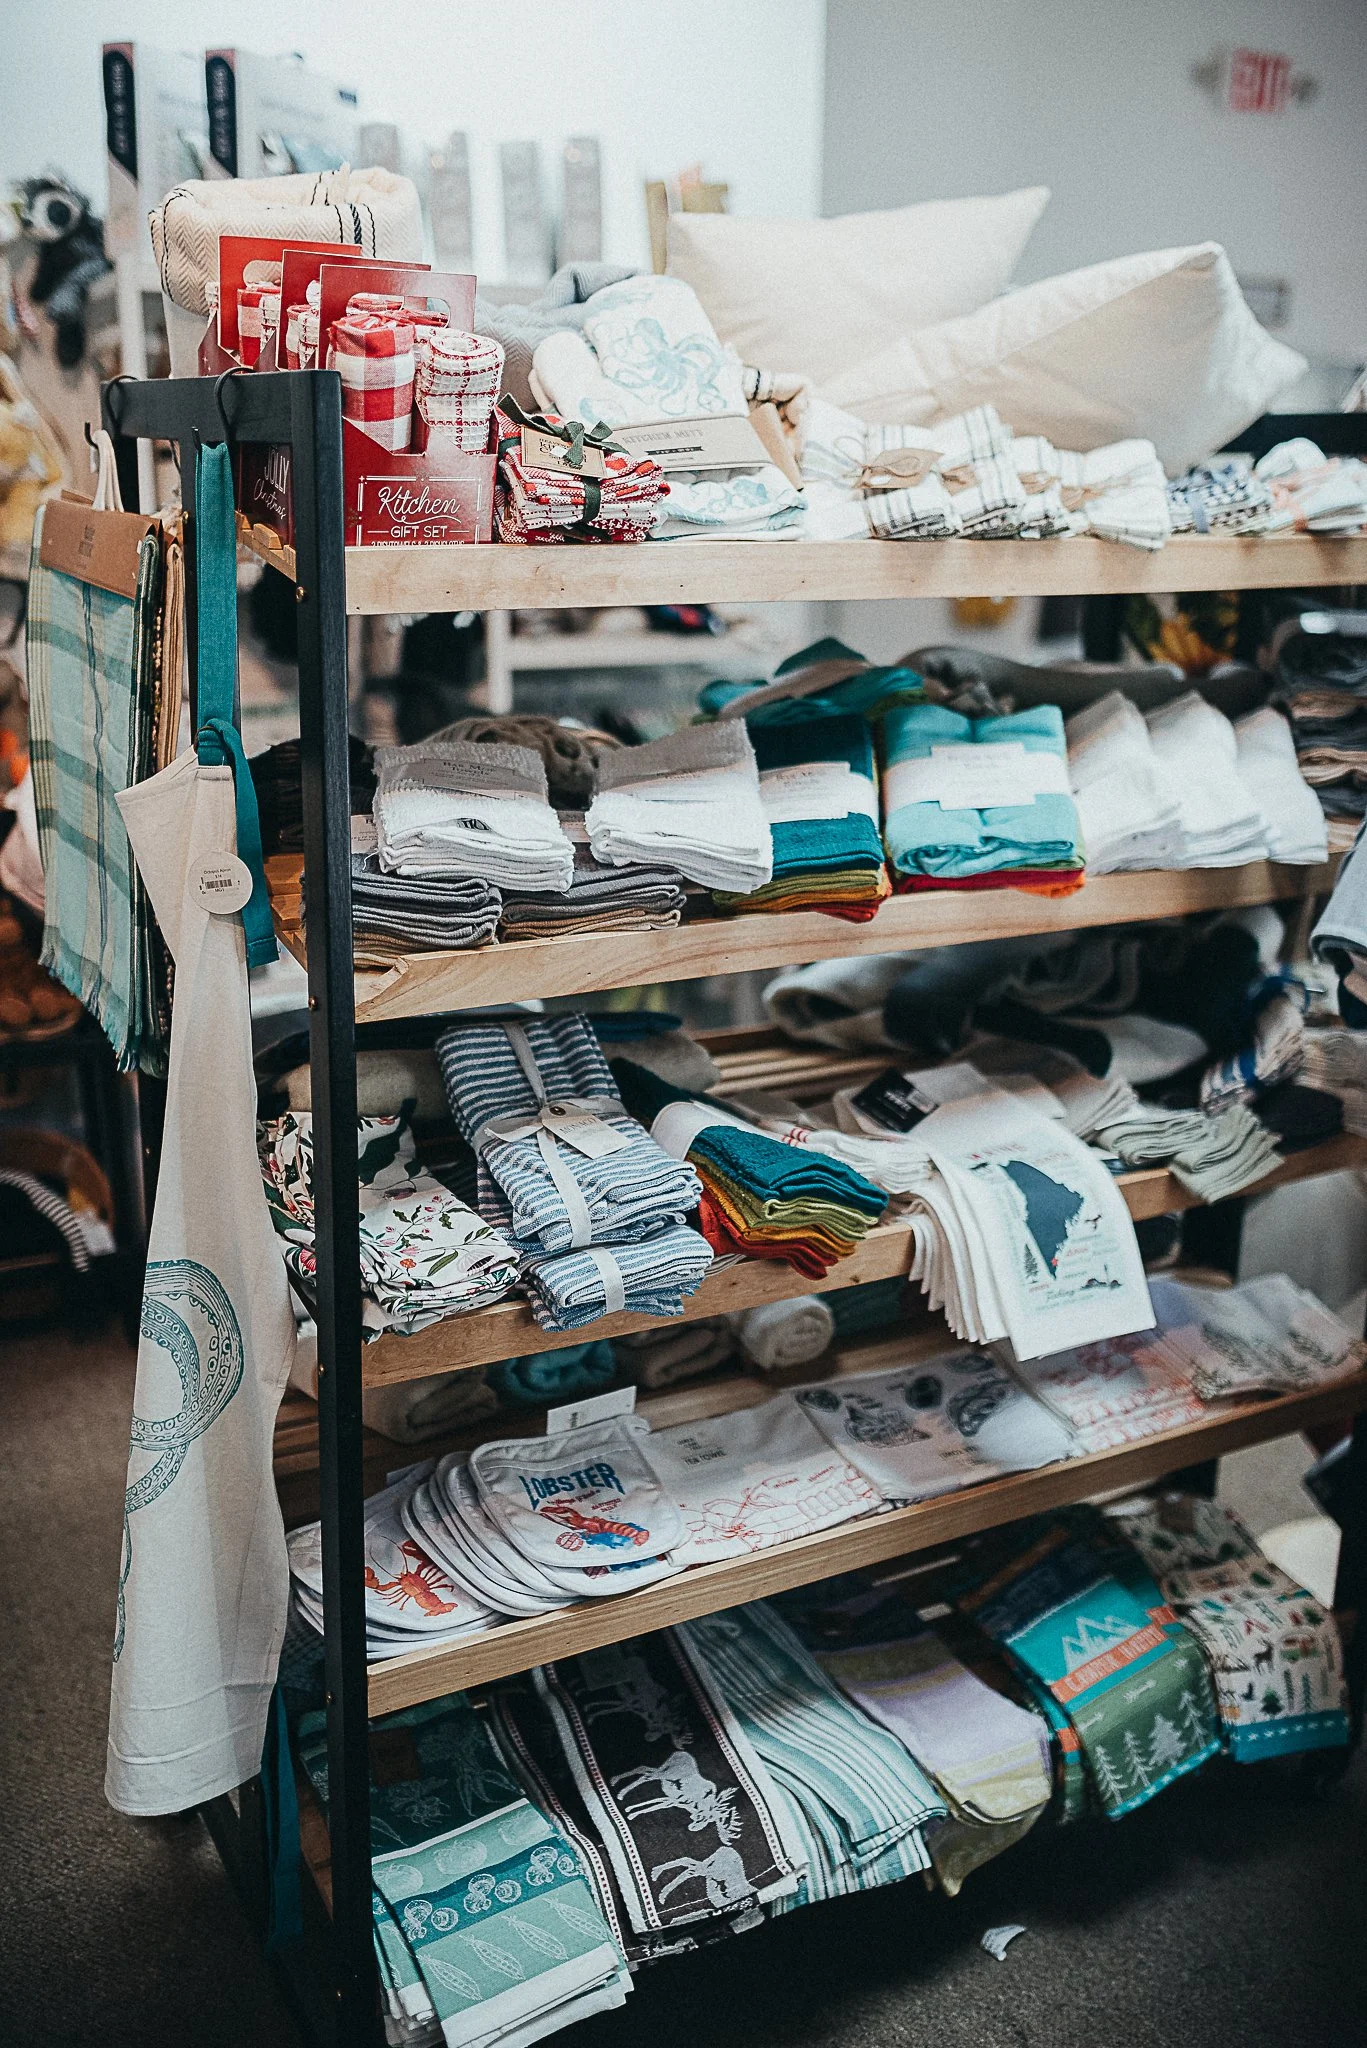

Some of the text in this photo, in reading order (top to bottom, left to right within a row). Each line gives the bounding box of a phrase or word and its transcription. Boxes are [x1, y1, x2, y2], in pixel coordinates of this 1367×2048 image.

[378, 486, 461, 518] Kitchen
[390, 526, 448, 538] GIFT SET
[518, 1462, 626, 1511] LOBSTER
